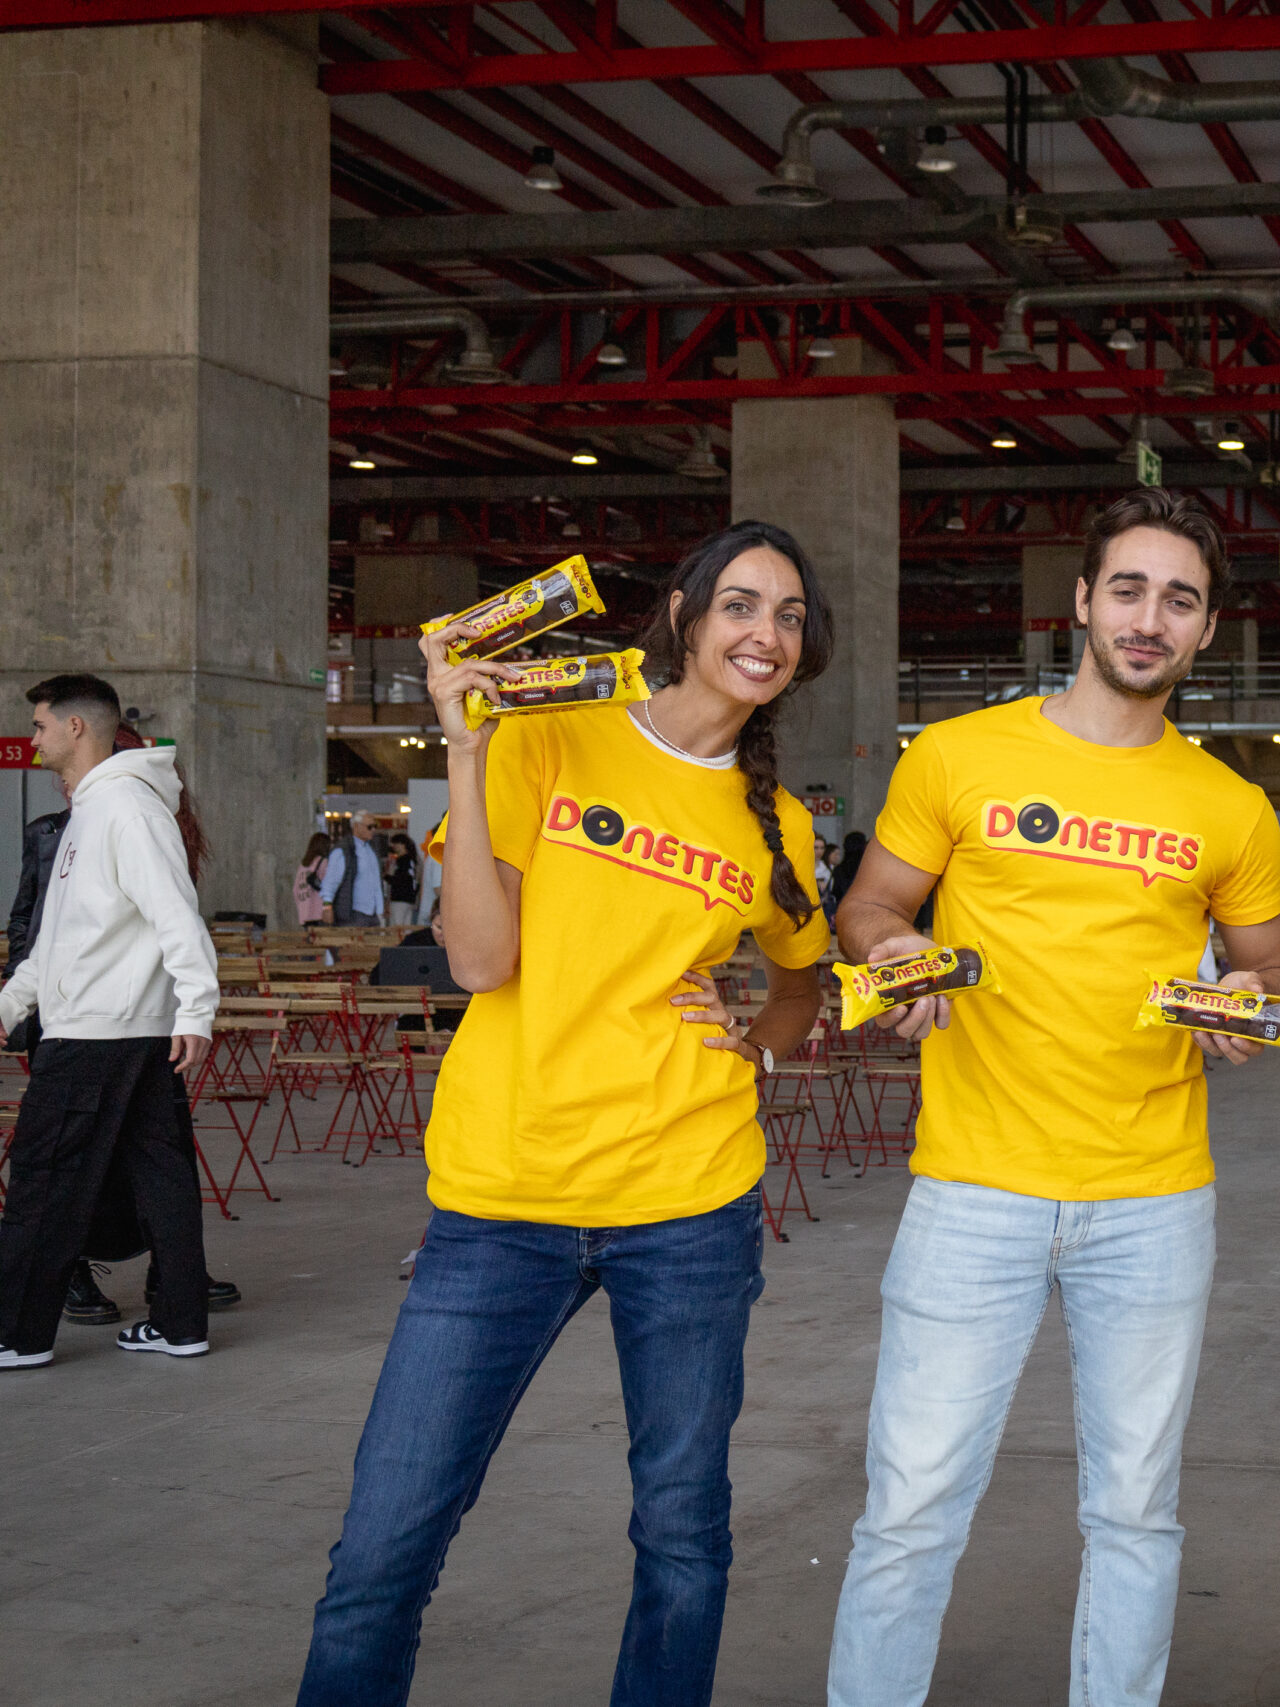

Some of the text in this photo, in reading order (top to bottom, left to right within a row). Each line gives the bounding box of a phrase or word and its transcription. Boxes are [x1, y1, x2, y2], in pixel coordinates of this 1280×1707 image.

[6, 745, 22, 761] 53
[546, 795, 755, 904] DONETTES
[986, 802, 1199, 871] DONETTES
[871, 958, 941, 987] DONETTES
[1161, 985, 1241, 1011] DONETTES
